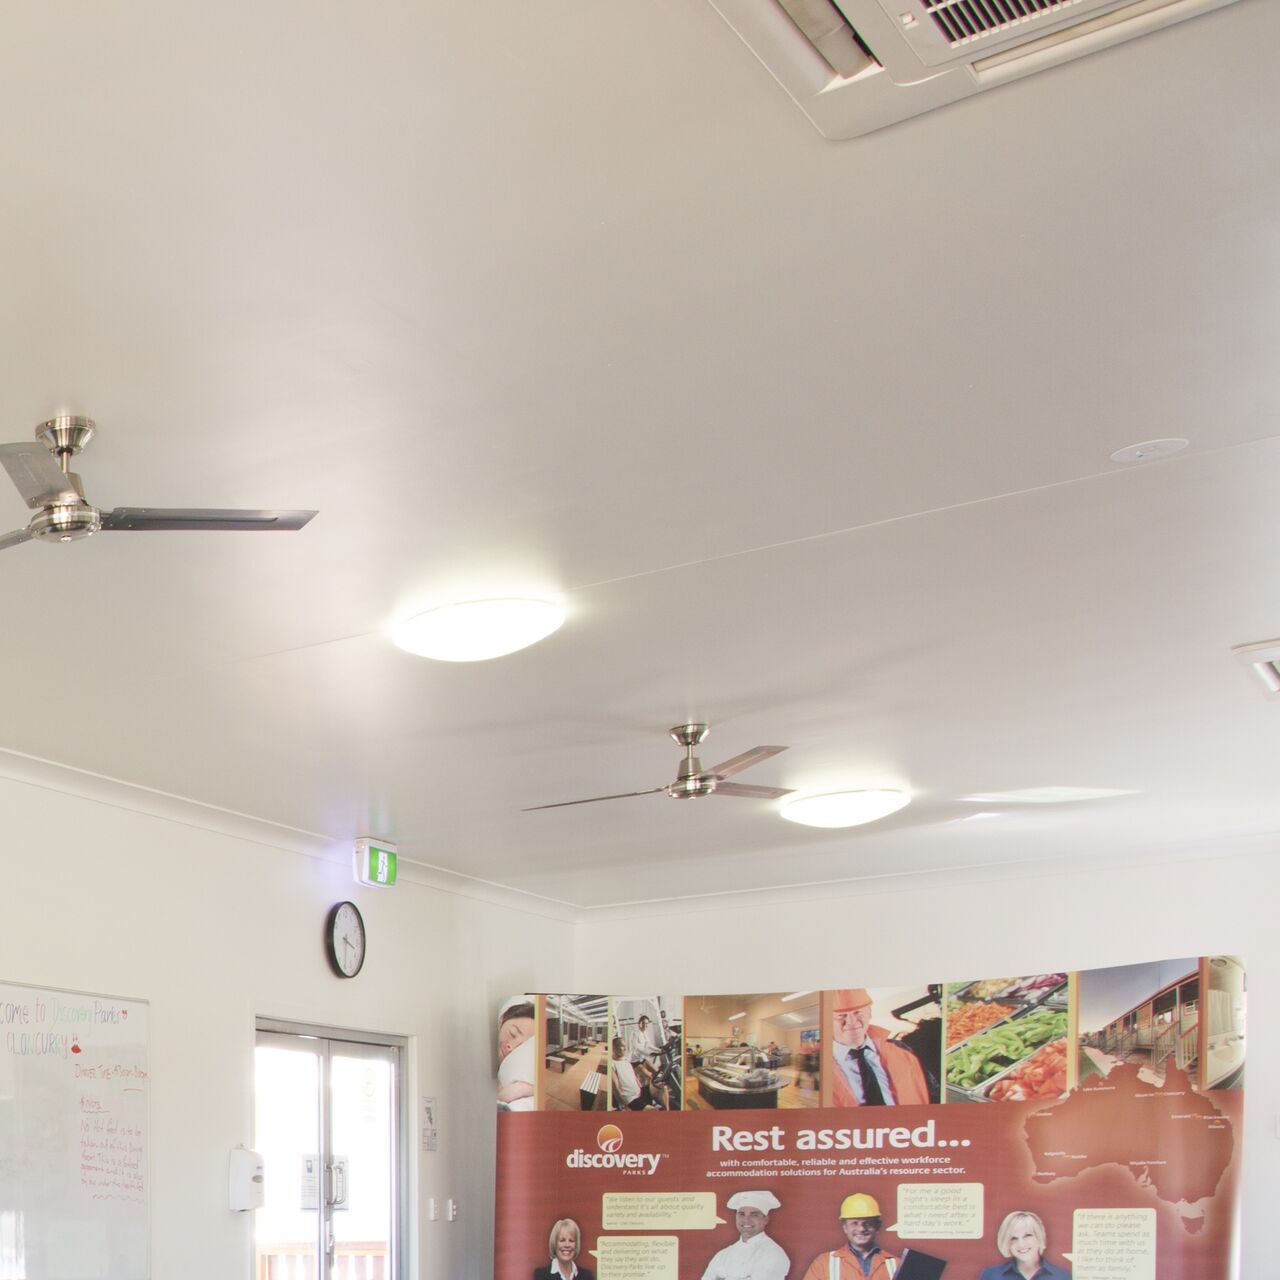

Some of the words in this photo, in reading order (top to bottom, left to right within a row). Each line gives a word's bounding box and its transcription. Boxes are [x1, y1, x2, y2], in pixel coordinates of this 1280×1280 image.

[35, 993, 46, 1024] to
[6, 1031, 68, 1059] CLONCURRY
[712, 1126, 785, 1151] Rest
[796, 1119, 971, 1150] assured...
[566, 1149, 661, 1175] discovery
[706, 1168, 778, 1178] accommodation
[780, 1168, 821, 1177] solutions
[823, 1167, 837, 1176] for
[839, 1167, 888, 1176] Australia's
[889, 1167, 931, 1175] resource
[932, 1166, 966, 1174] sector.
[720, 1159, 740, 1167] with
[742, 1157, 800, 1169] comfortable,
[801, 1157, 837, 1166] reliable
[839, 1156, 857, 1165] and
[859, 1156, 899, 1165] effective
[901, 1155, 951, 1164] workforce
